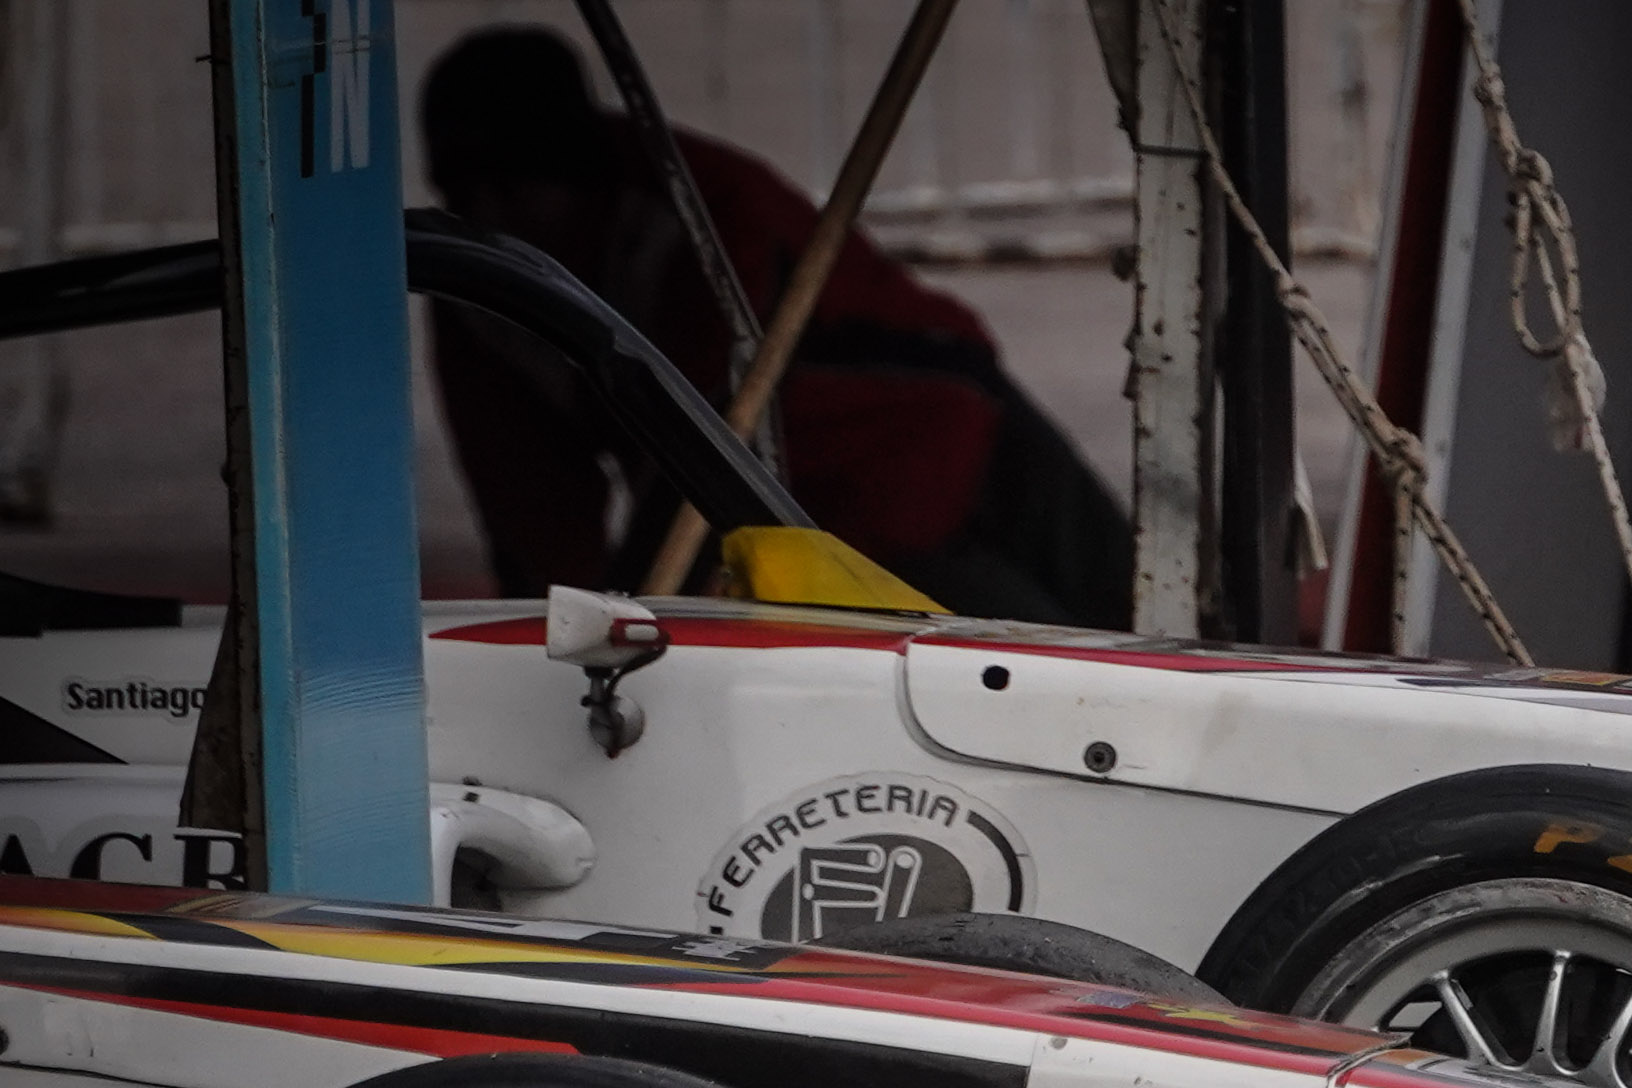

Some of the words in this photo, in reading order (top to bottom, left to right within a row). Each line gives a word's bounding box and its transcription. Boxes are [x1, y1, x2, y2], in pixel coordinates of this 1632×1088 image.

[67, 682, 208, 717] Santiago
[708, 784, 959, 917] FERRETERIA
[1533, 822, 1604, 854] P
